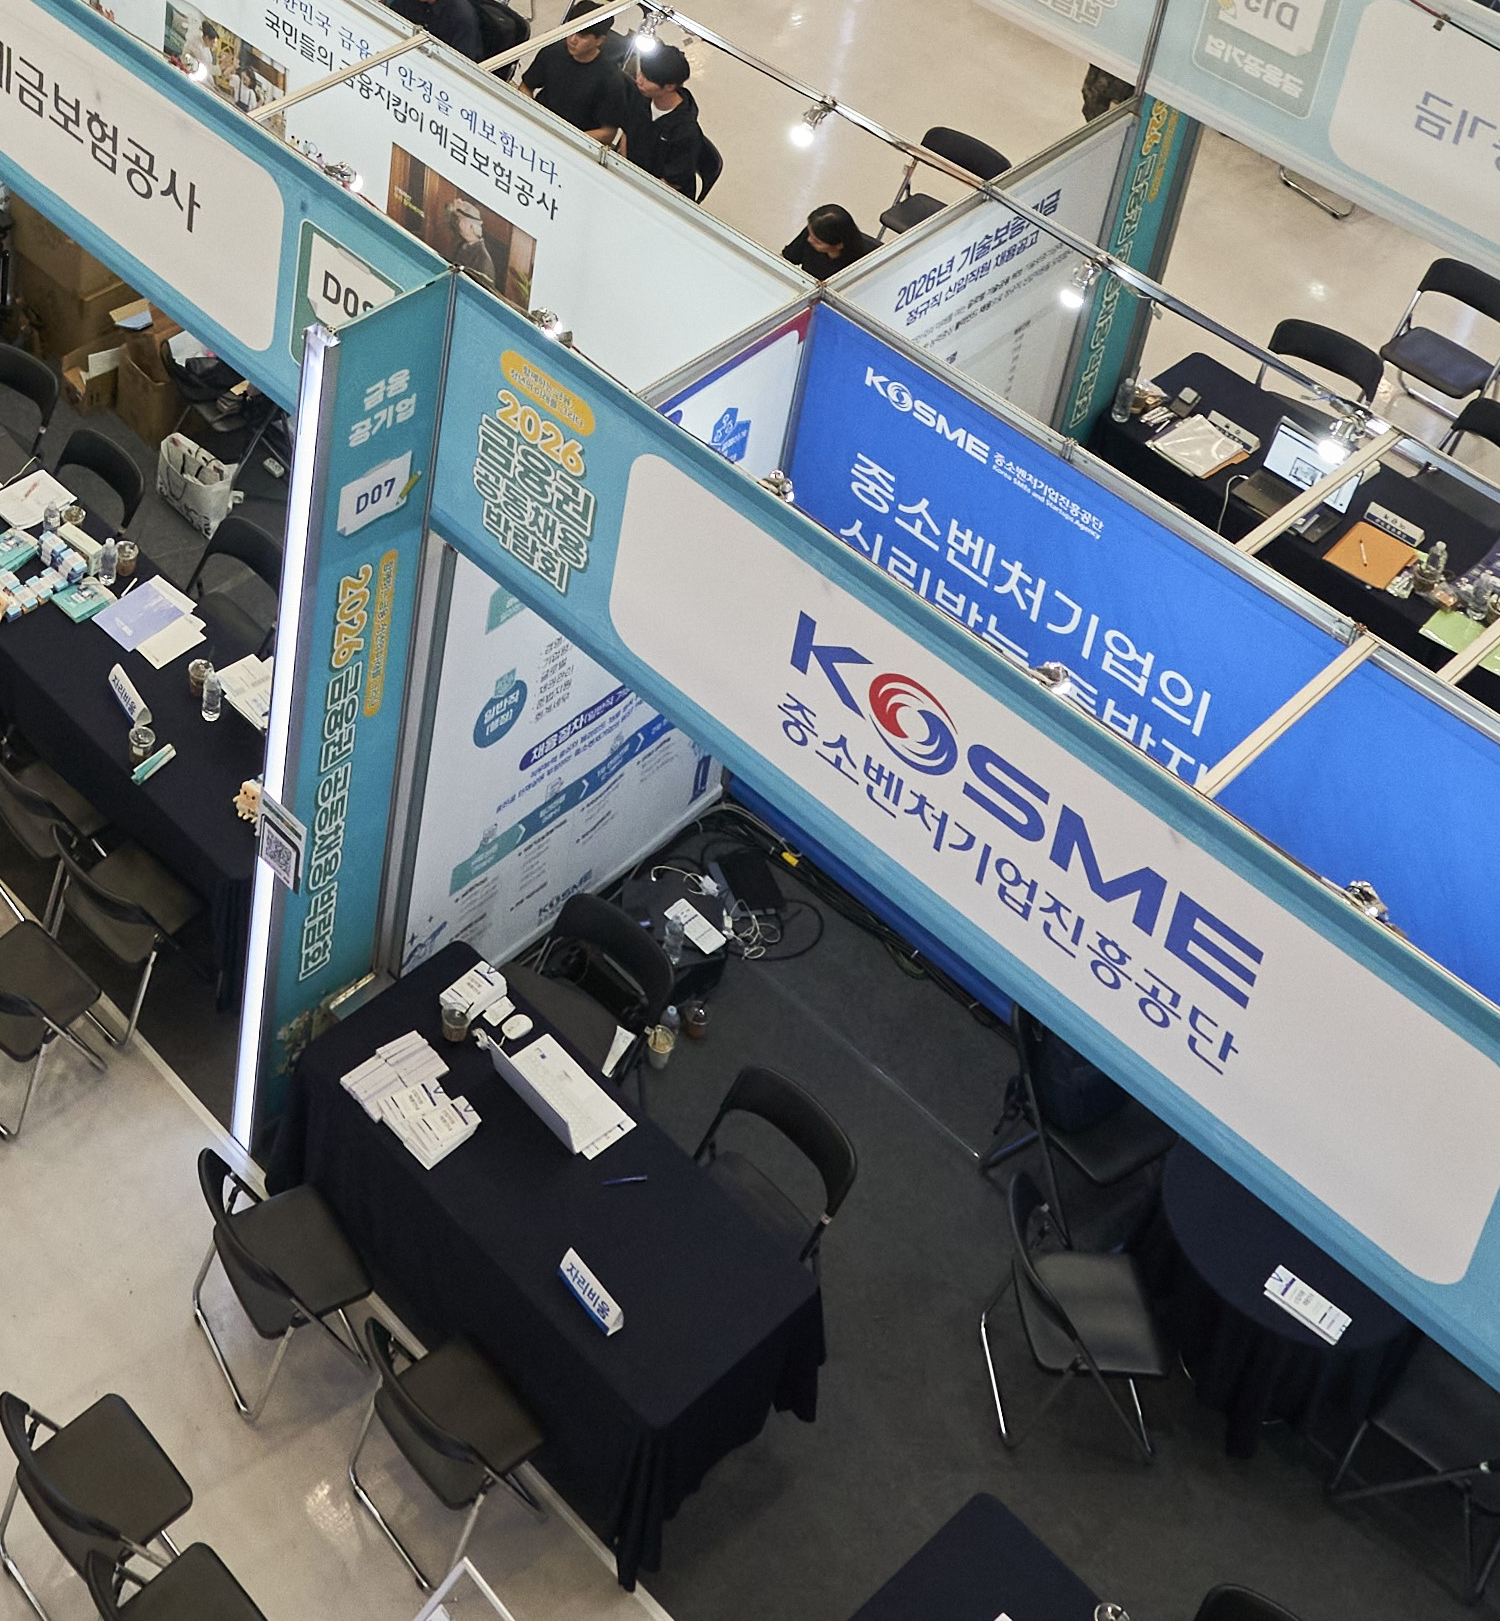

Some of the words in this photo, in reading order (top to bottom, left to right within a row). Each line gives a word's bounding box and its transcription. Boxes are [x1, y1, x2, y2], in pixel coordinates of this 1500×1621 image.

[265, 9, 333, 71] 국민들의
[430, 124, 559, 221] 예금보험공사
[399, 66, 453, 114] 안정을
[461, 107, 562, 188] 예보합니다.
[894, 255, 955, 312] 2026년
[906, 295, 941, 326] 정규직
[945, 260, 991, 302] 신입직원
[994, 230, 1040, 270] 채용공고
[347, 393, 418, 444] 공기업
[363, 368, 412, 413] 금융
[496, 388, 587, 476] 2026
[864, 366, 990, 464] KOSME
[353, 484, 396, 518] D07
[473, 458, 587, 569] 공동채용
[478, 413, 595, 538] 금융권
[992, 452, 1105, 531] 중소벤처기업진흥공단
[483, 504, 568, 593] 박람회
[850, 453, 1212, 736] 중소벤처기업의
[788, 609, 1265, 1010] KOSME
[777, 690, 1240, 1078] 중소벤처기업진흥공단
